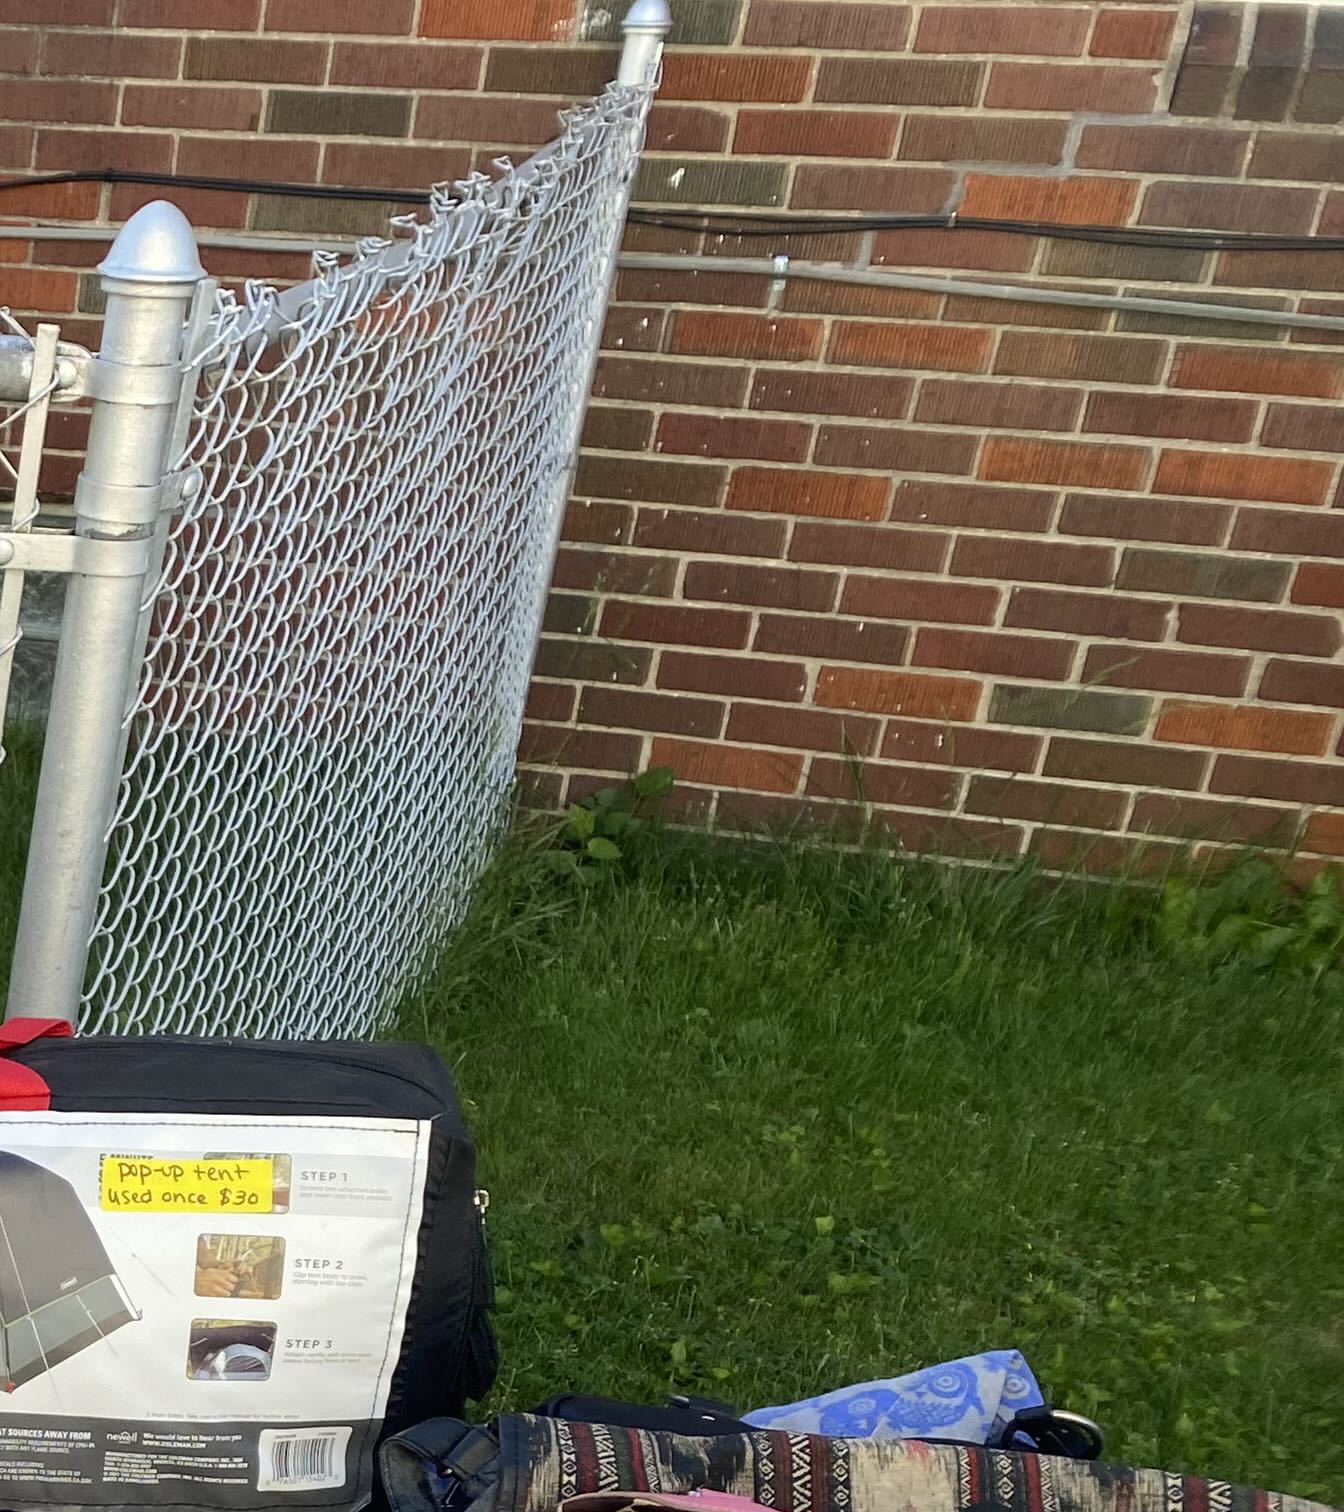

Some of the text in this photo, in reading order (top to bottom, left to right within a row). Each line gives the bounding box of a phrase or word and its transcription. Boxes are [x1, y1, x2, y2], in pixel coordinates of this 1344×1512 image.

[193, 1163, 251, 1181] tent
[300, 1170, 348, 1181] STEP 1
[161, 1192, 209, 1206] once
[219, 1187, 260, 1206] $30
[294, 1258, 343, 1270] STEP 2
[286, 1339, 333, 1349] STEP 3
[8, 1428, 43, 1437] SOURCES
[44, 1430, 69, 1439] AWAY
[69, 1431, 91, 1440] FROM
[106, 1431, 138, 1442] newell
